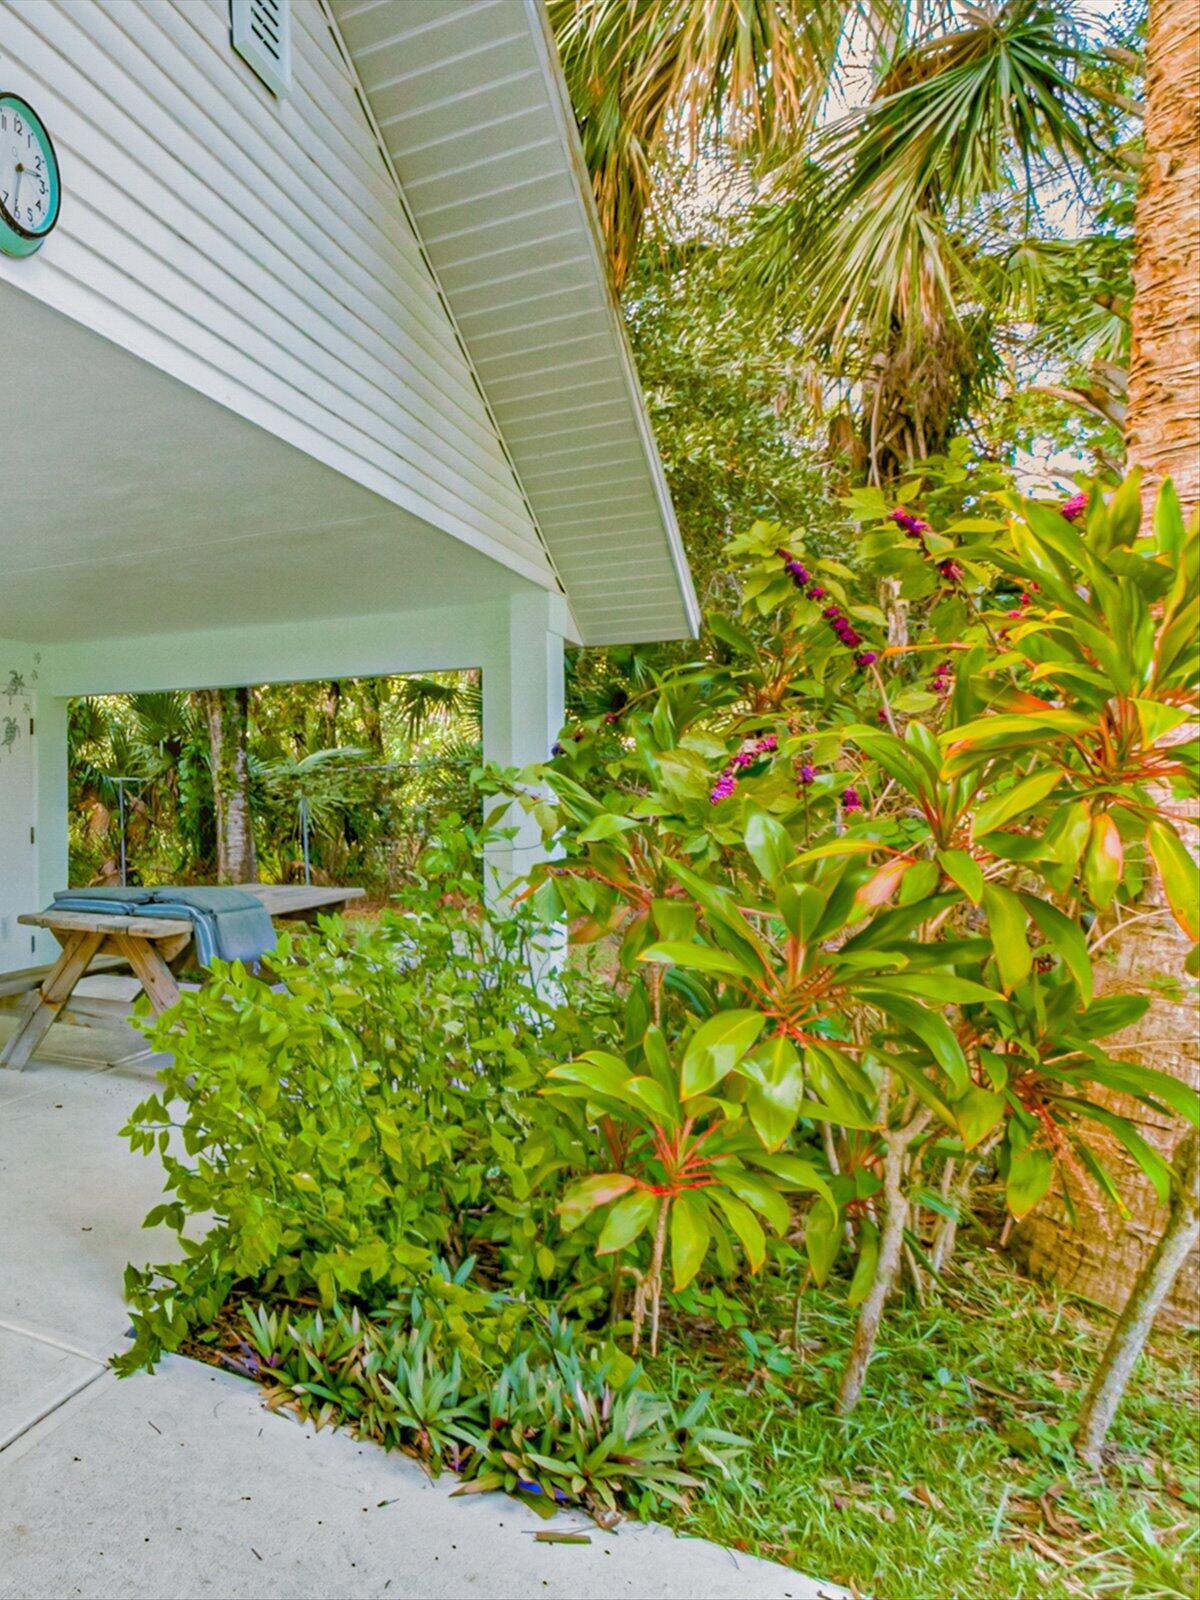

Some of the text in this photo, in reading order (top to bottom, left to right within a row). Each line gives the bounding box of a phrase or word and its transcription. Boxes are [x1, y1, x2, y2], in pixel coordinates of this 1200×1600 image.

[1, 114, 7, 131] 11
[13, 117, 23, 136] 12
[27, 134, 31, 148] 1
[35, 155, 42, 171] 2
[39, 179, 46, 195] 3
[2, 190, 9, 203] 7
[35, 199, 42, 212] 4
[27, 207, 33, 222] 5
